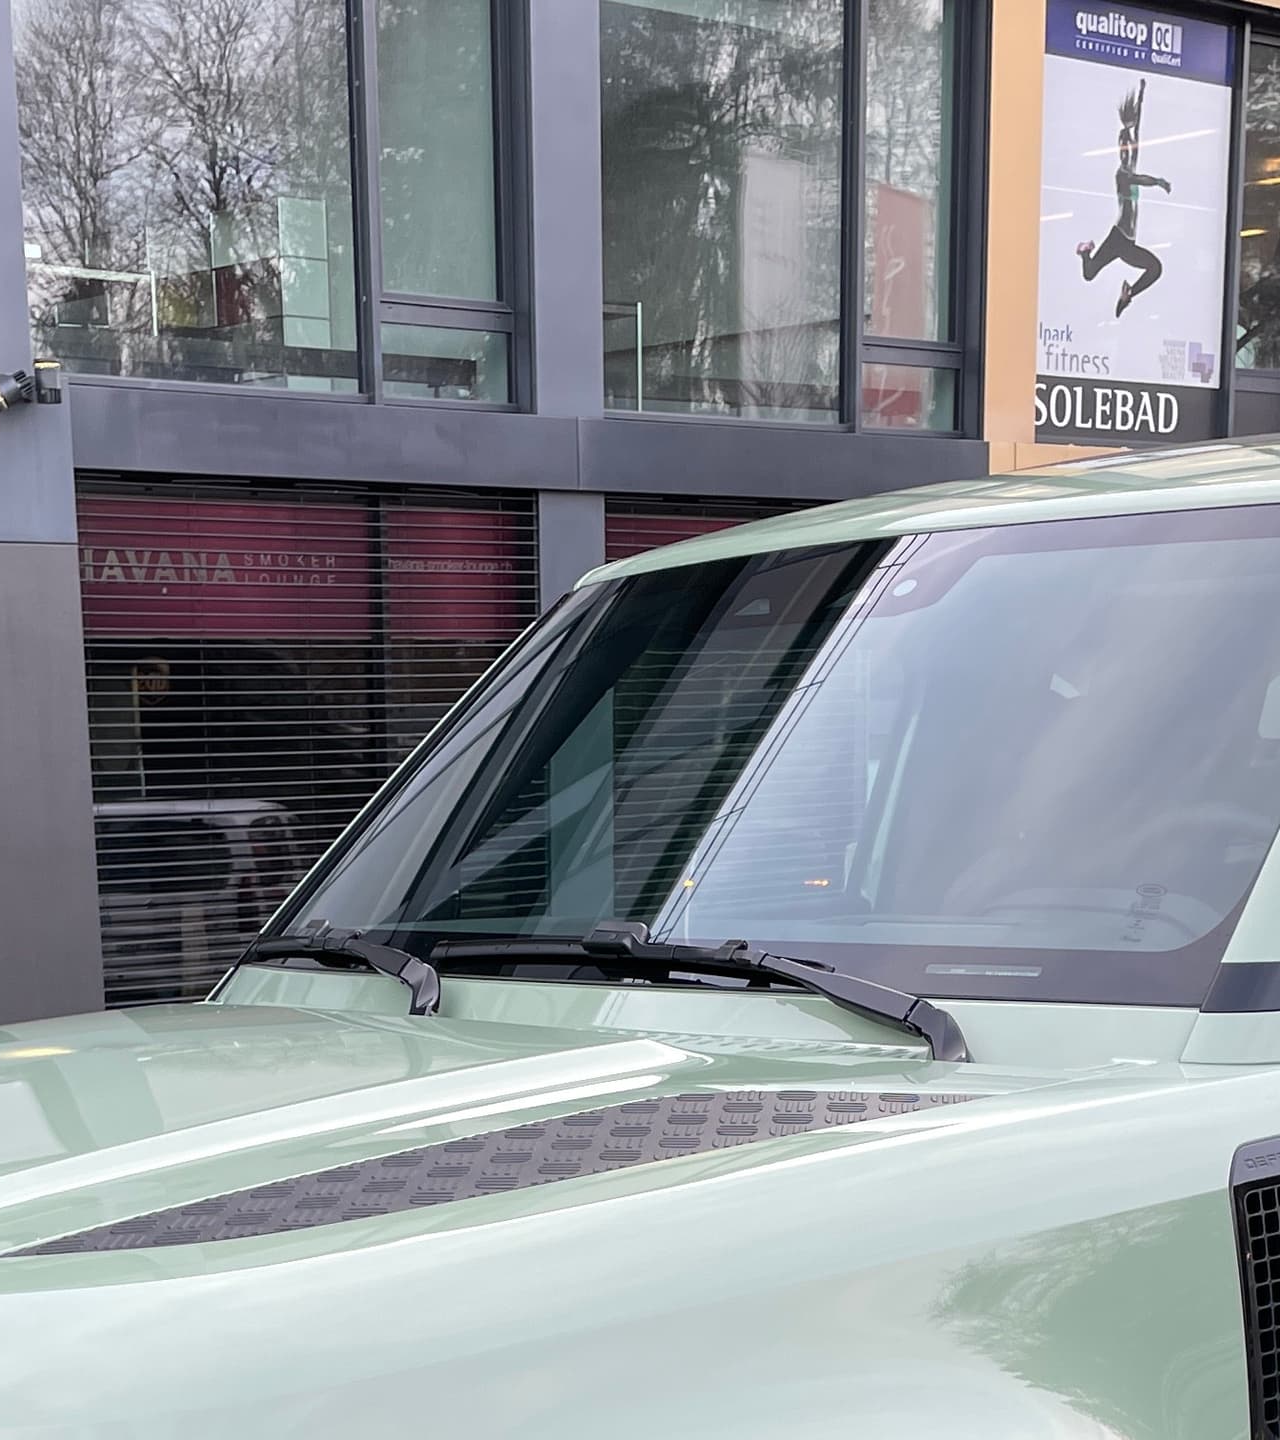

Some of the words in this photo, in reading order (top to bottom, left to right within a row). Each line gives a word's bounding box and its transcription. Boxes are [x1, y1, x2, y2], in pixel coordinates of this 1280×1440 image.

[1075, 11, 1148, 46] qualitop
[1045, 344, 1110, 375] fitness
[1034, 382, 1179, 434] SOLEBAD
